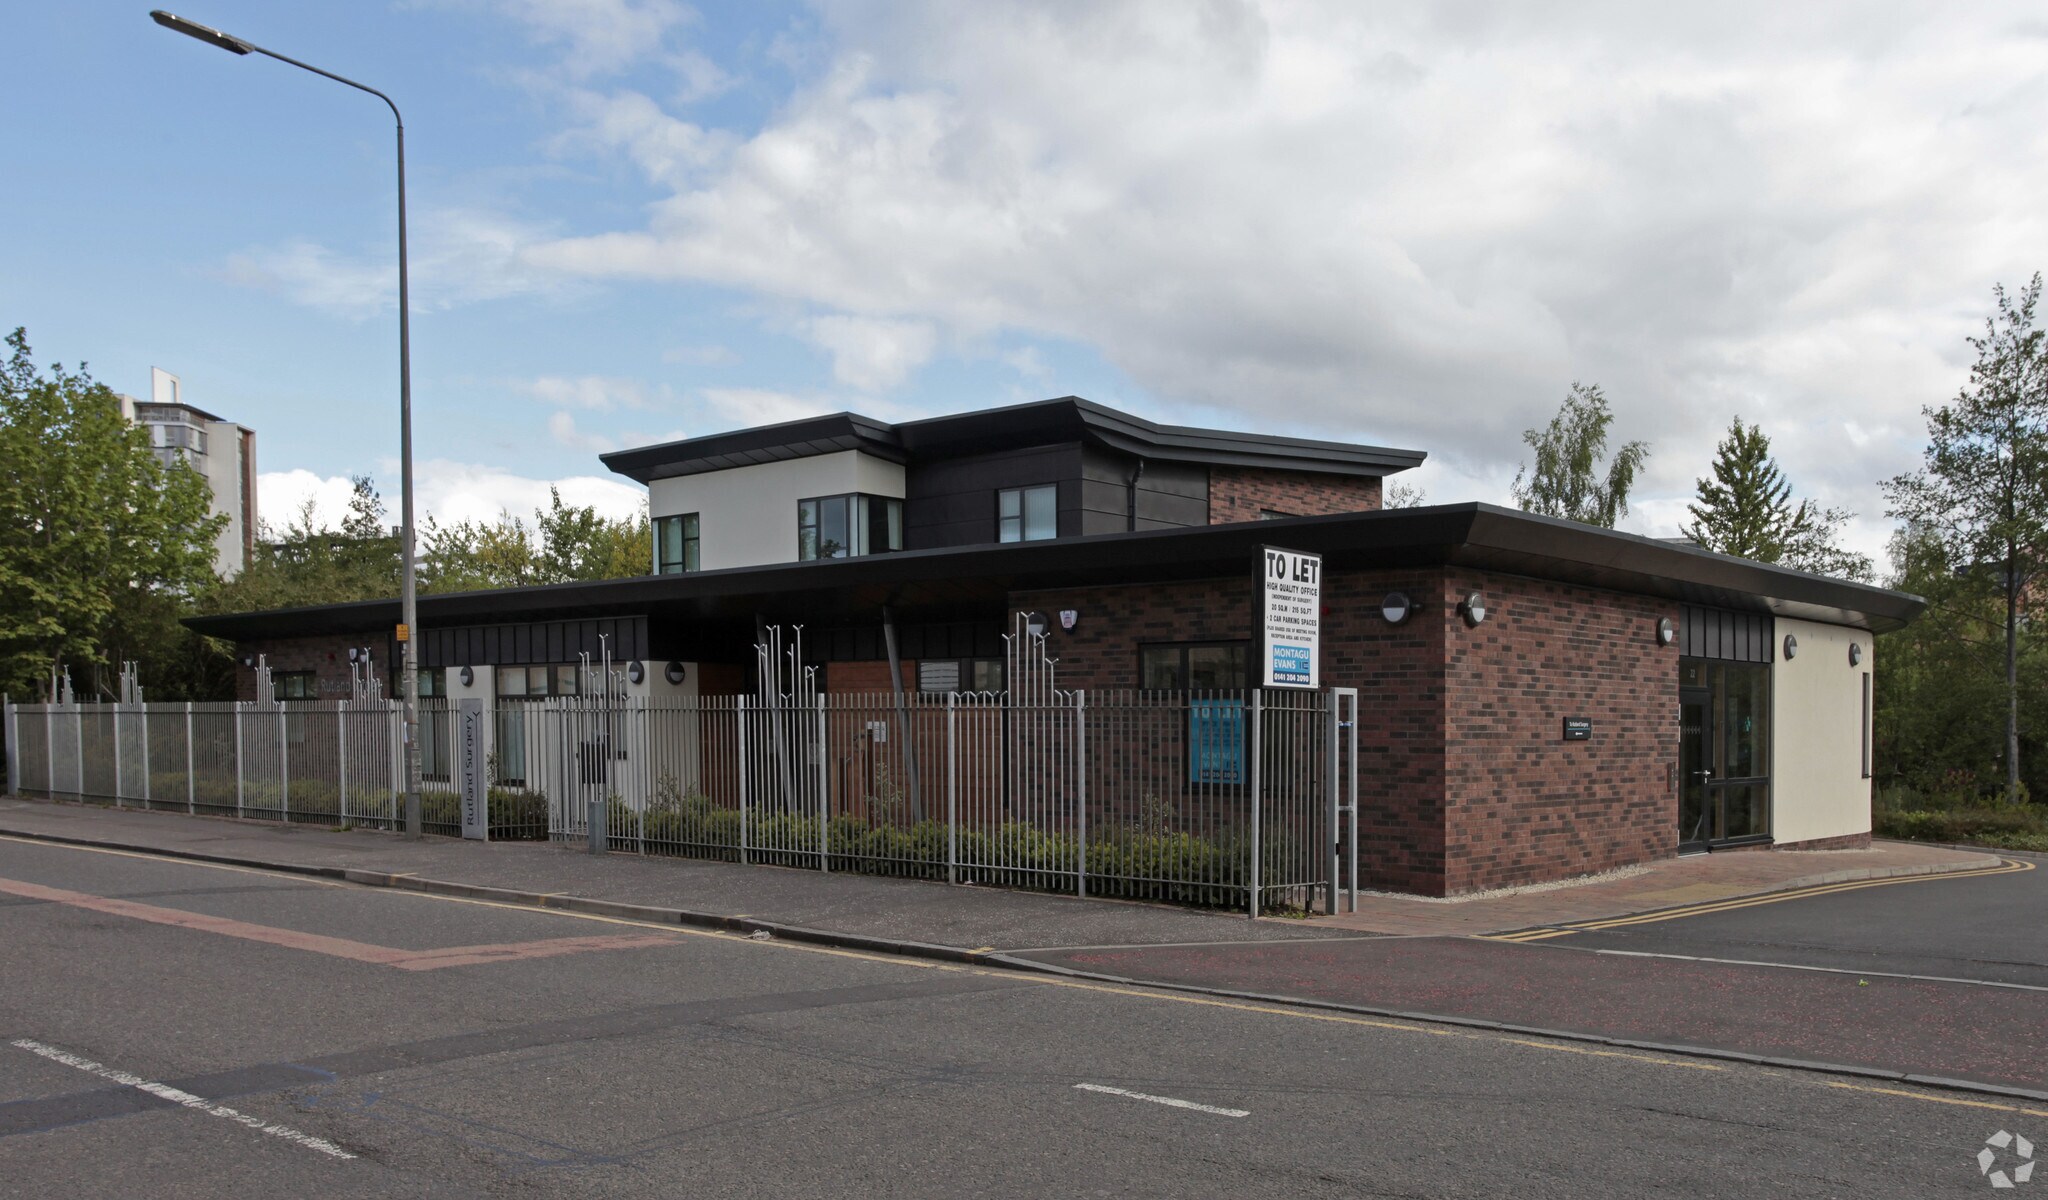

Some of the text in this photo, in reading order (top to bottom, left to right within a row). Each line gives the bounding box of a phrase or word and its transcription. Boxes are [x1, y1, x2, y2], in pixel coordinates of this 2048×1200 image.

[1267, 552, 1318, 584] TO LET
[1267, 582, 1317, 596] HIGH QUALITY OFFICE
[1283, 616, 1300, 624] PARKING
[1301, 618, 1316, 626] SPACES
[1274, 648, 1308, 659] MONTAGU
[1274, 659, 1296, 669] EVANS
[1192, 705, 1210, 718] TO
[466, 715, 474, 768] Surgery
